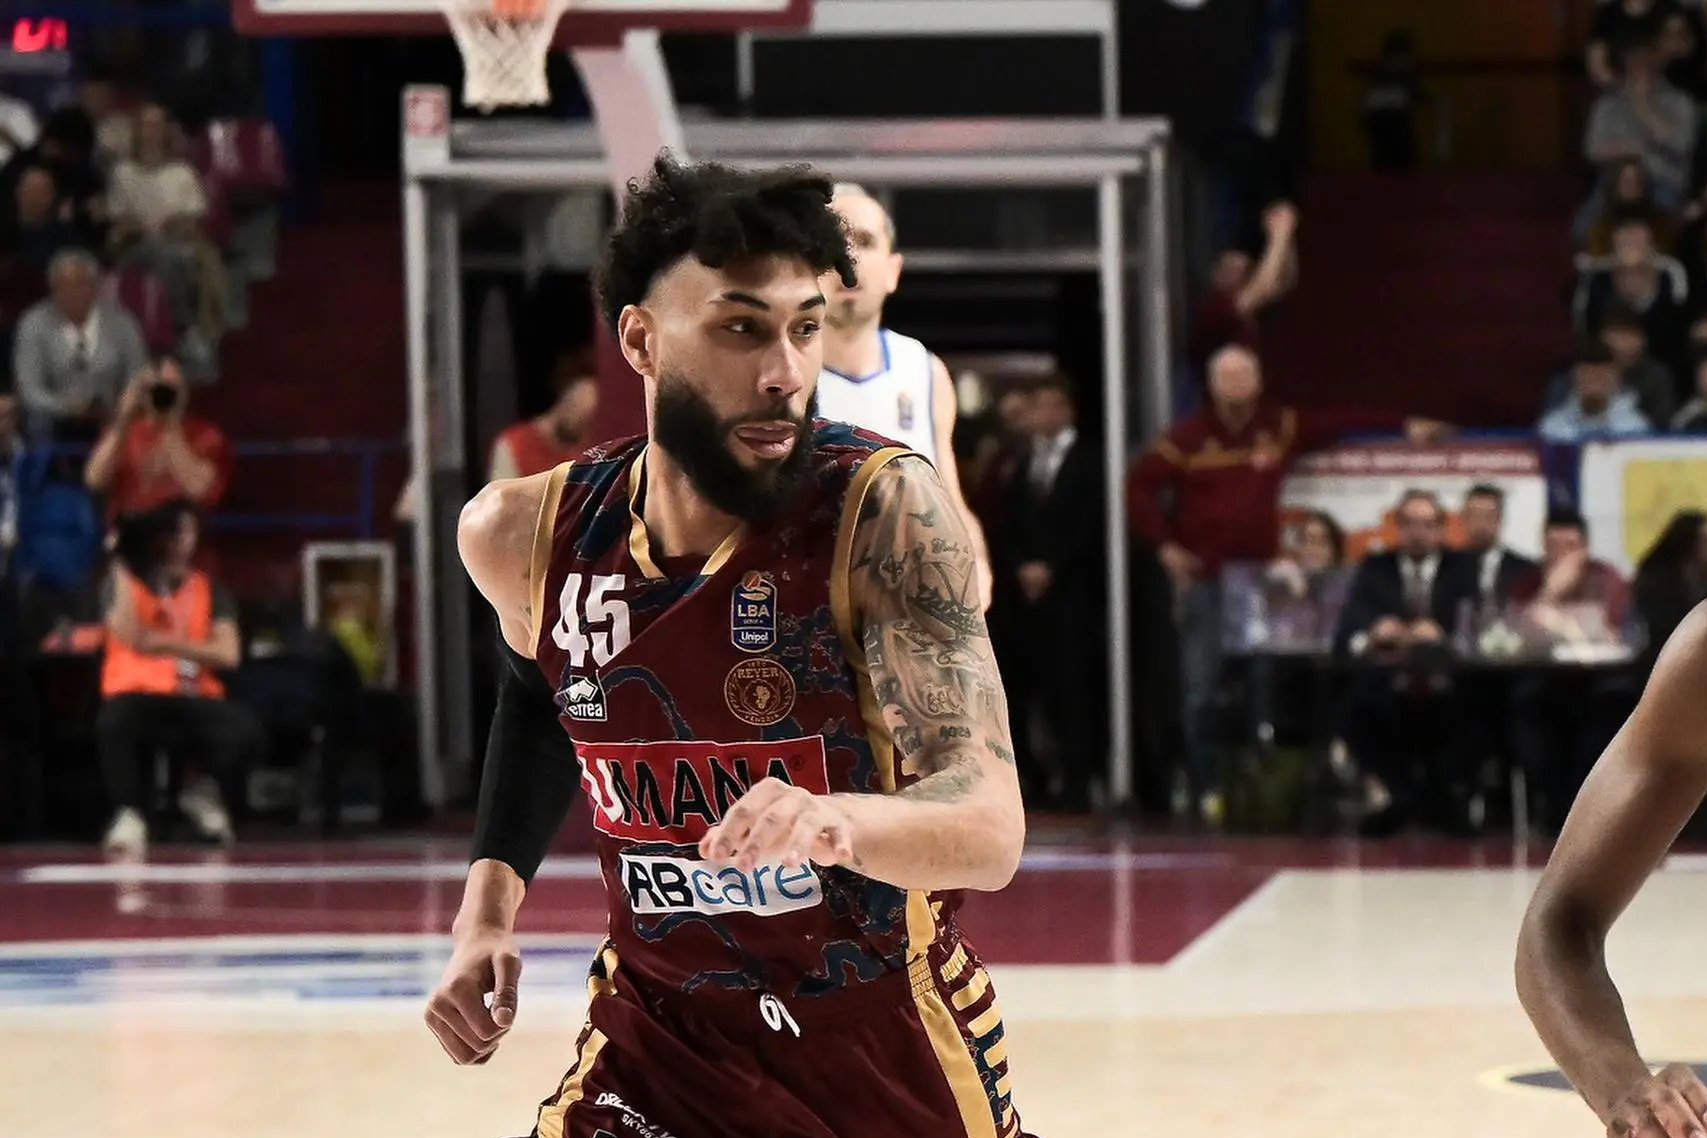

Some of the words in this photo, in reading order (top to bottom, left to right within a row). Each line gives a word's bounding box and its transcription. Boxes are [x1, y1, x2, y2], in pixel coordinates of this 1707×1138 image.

[737, 604, 771, 618] LBA
[551, 573, 632, 668] 45
[740, 631, 769, 644] Unipol
[736, 667, 779, 679] REYER
[627, 861, 813, 909] ABcare
